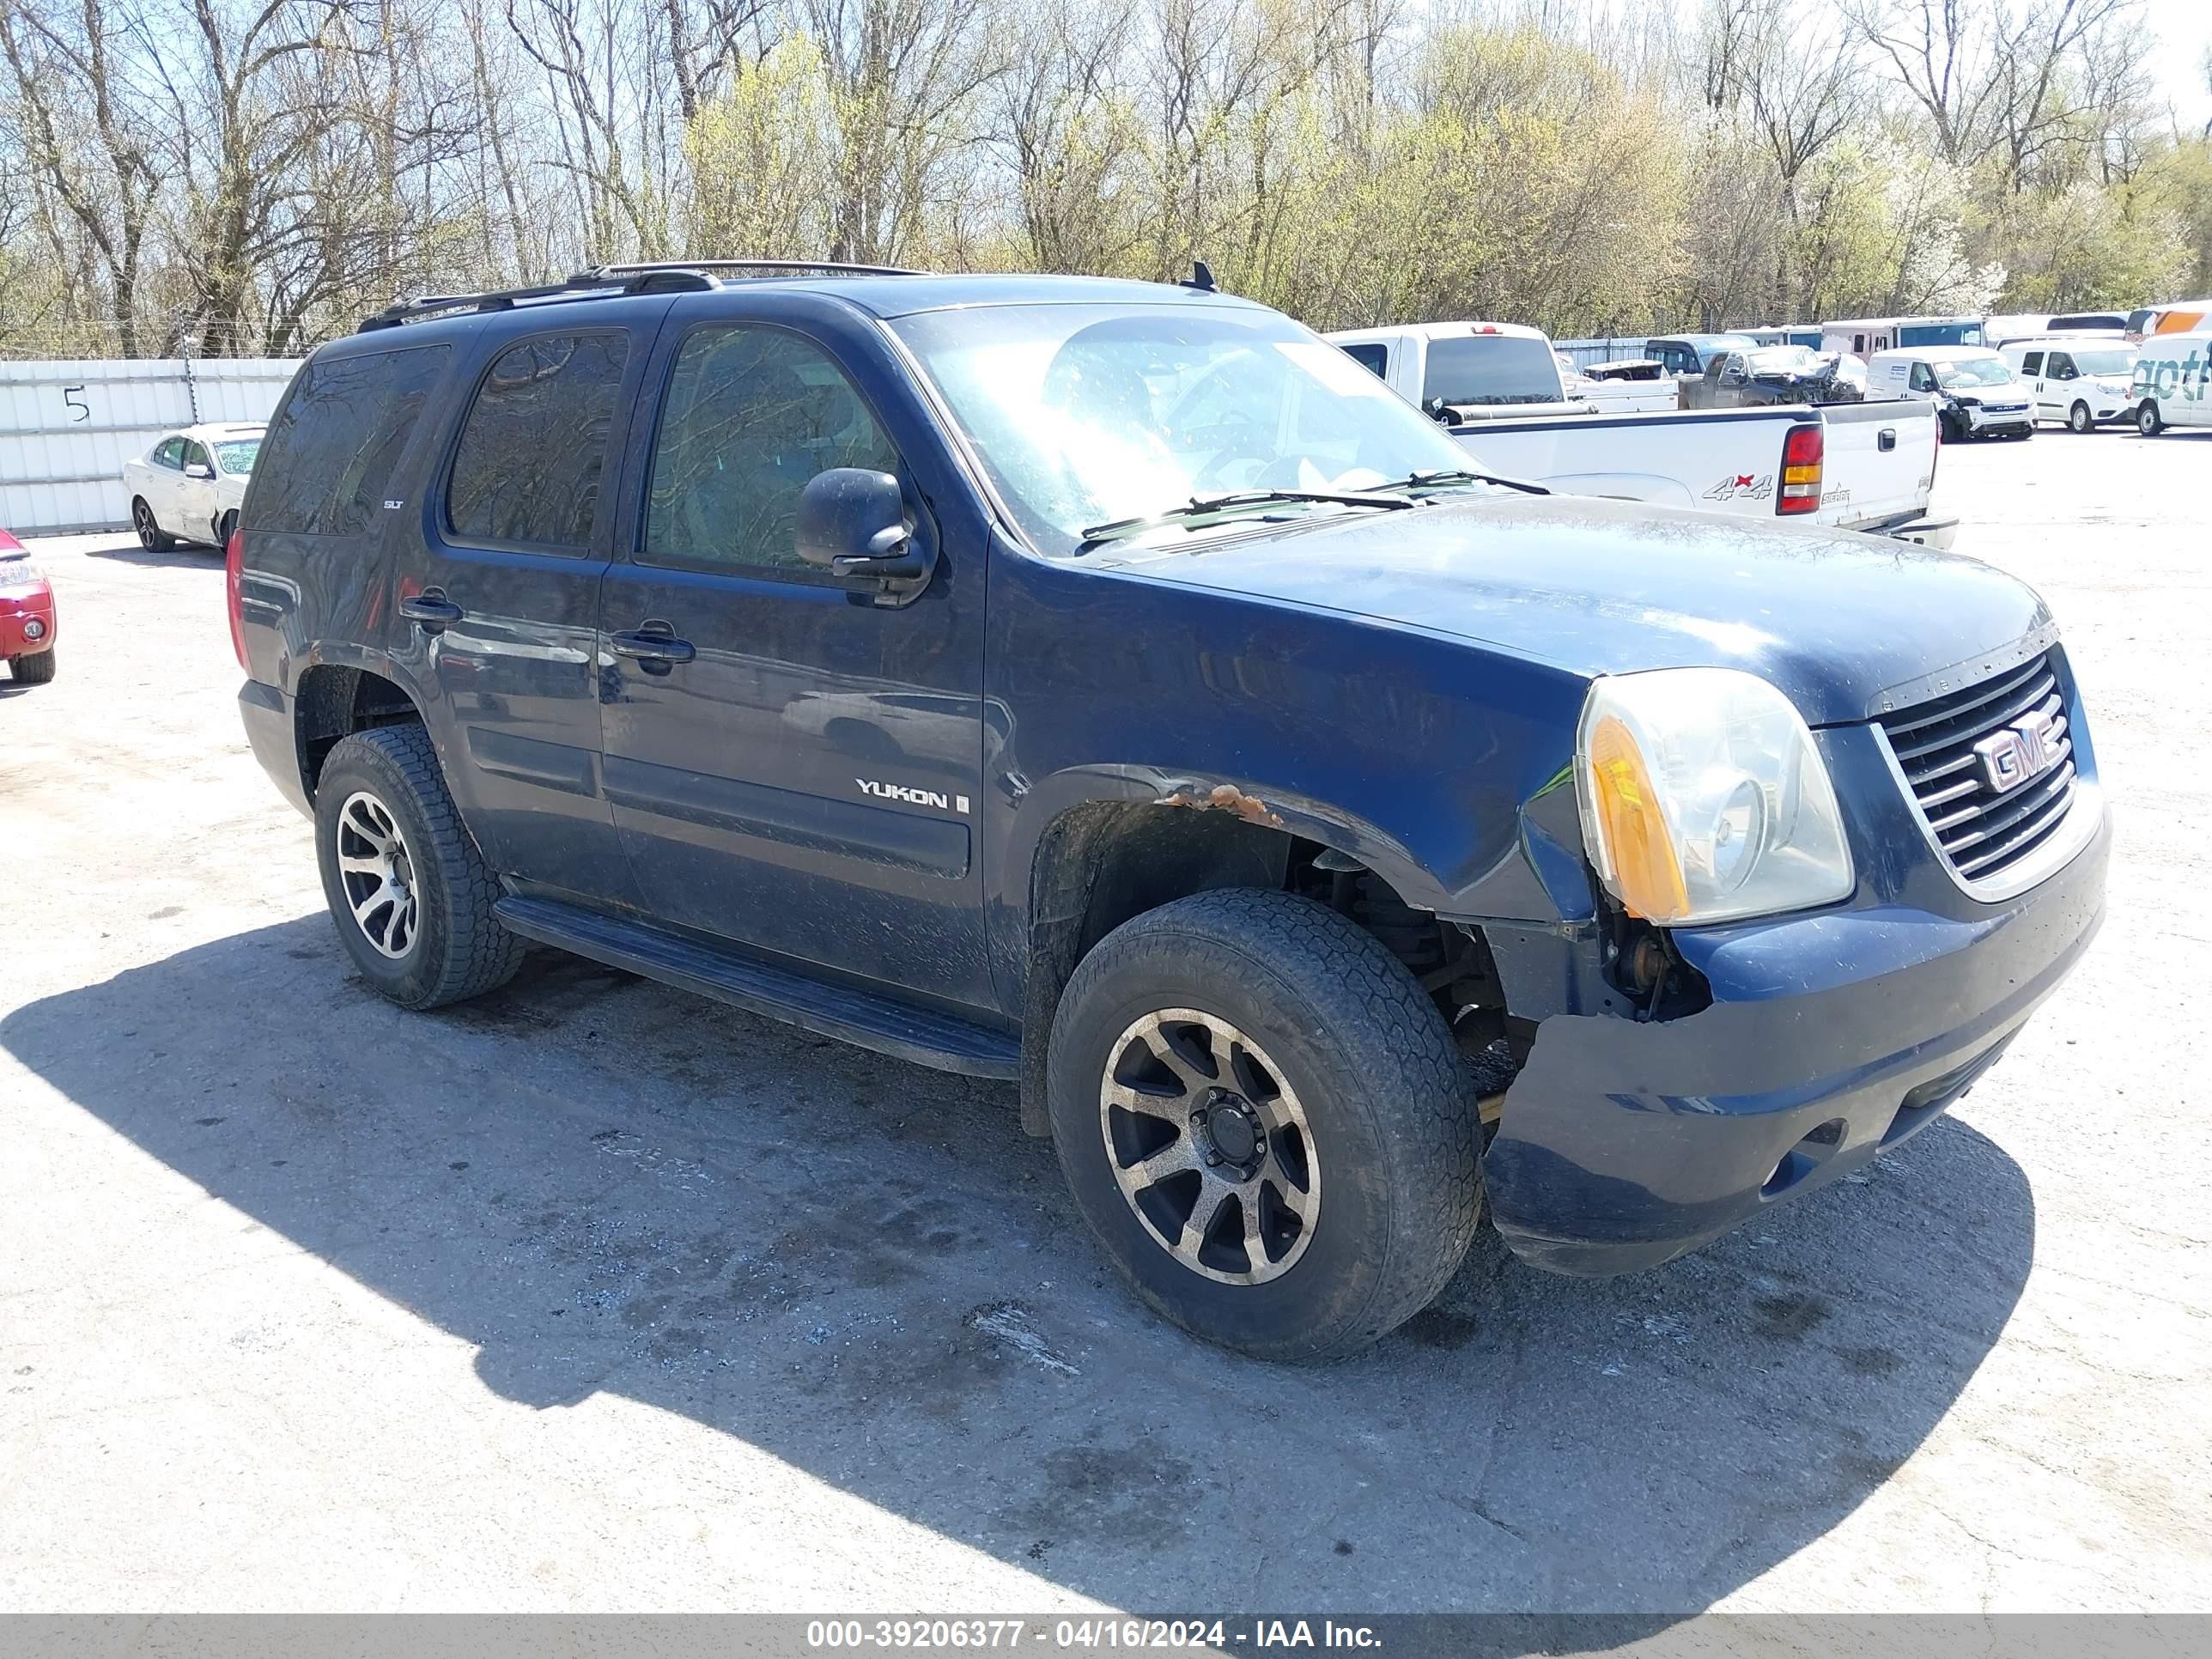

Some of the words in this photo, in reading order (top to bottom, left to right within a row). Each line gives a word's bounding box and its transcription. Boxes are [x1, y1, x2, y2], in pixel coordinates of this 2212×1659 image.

[2133, 349, 2212, 403] apti
[64, 385, 89, 422] 5
[383, 500, 404, 509] SLT
[1985, 714, 2062, 792] GMC
[854, 777, 948, 810] YUKON
